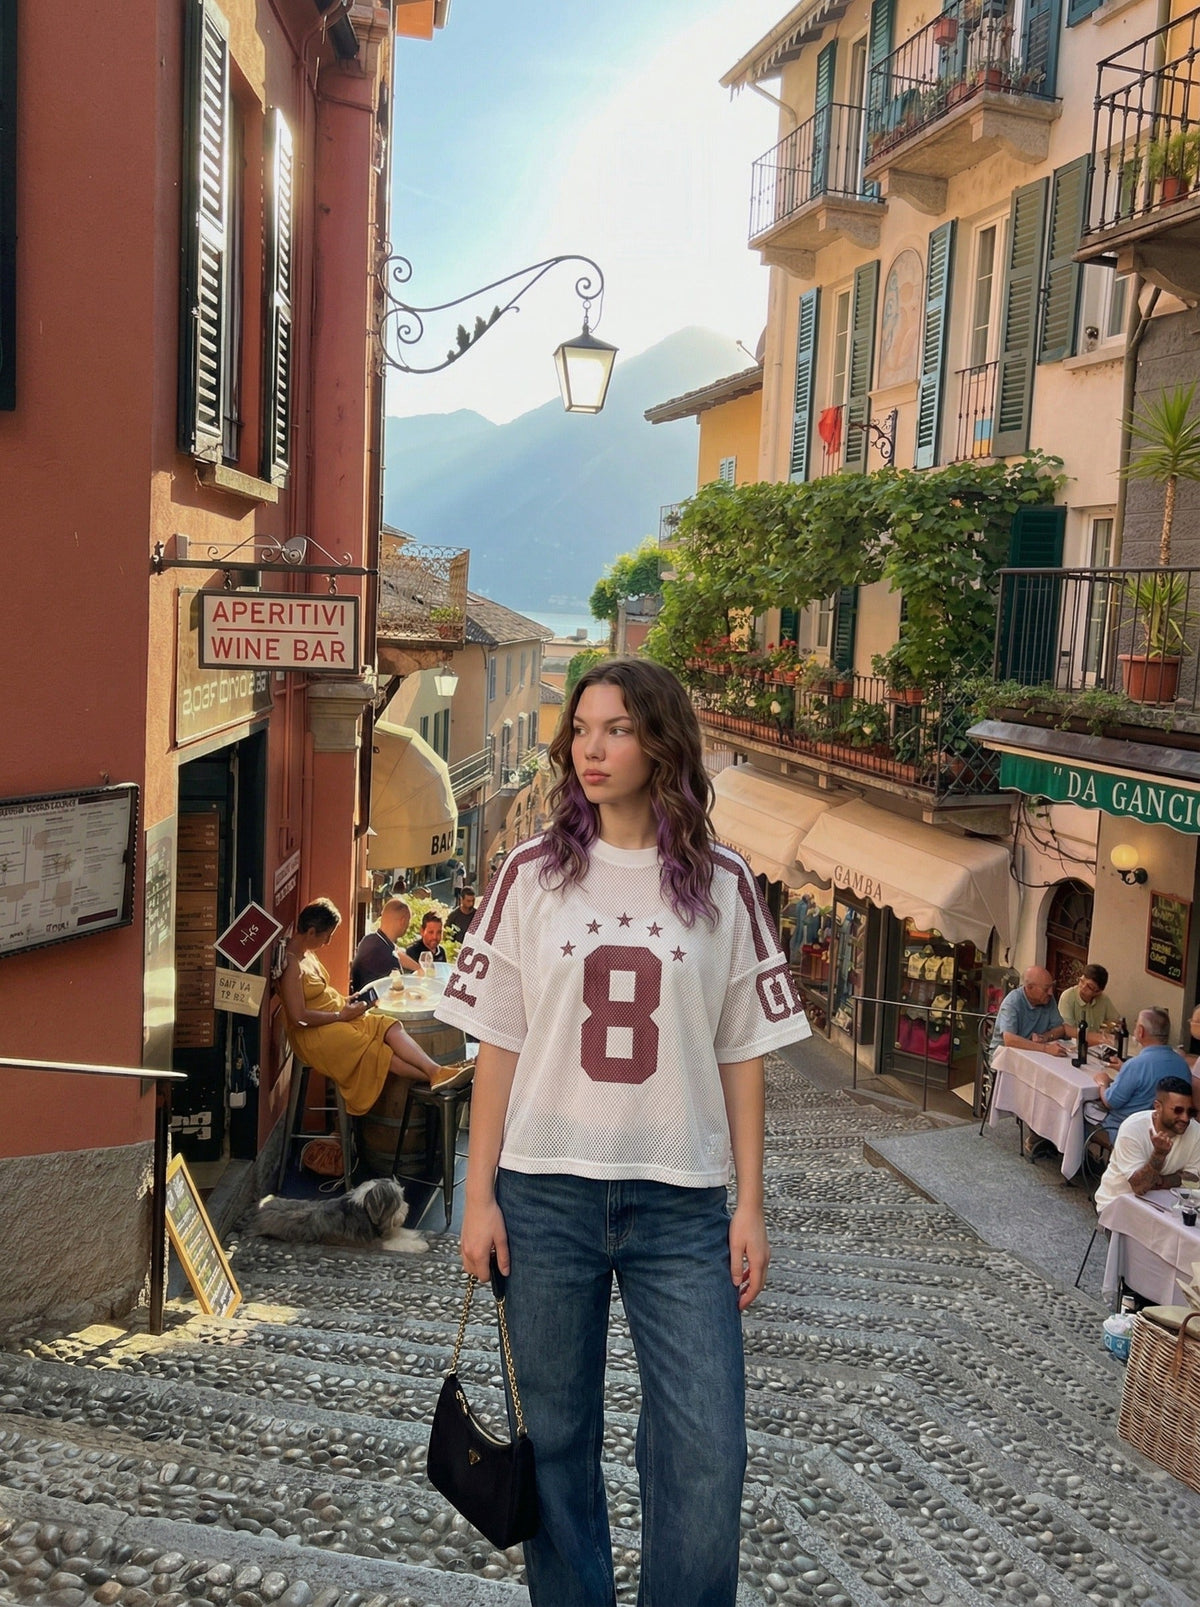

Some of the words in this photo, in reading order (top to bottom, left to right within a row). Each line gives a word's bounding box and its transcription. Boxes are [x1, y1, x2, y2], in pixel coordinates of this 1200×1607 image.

[212, 601, 345, 626] APERITIVI
[211, 636, 280, 660] WINE
[293, 639, 345, 662] BAR
[834, 865, 882, 901] GAMBA
[580, 944, 662, 1085] 8
